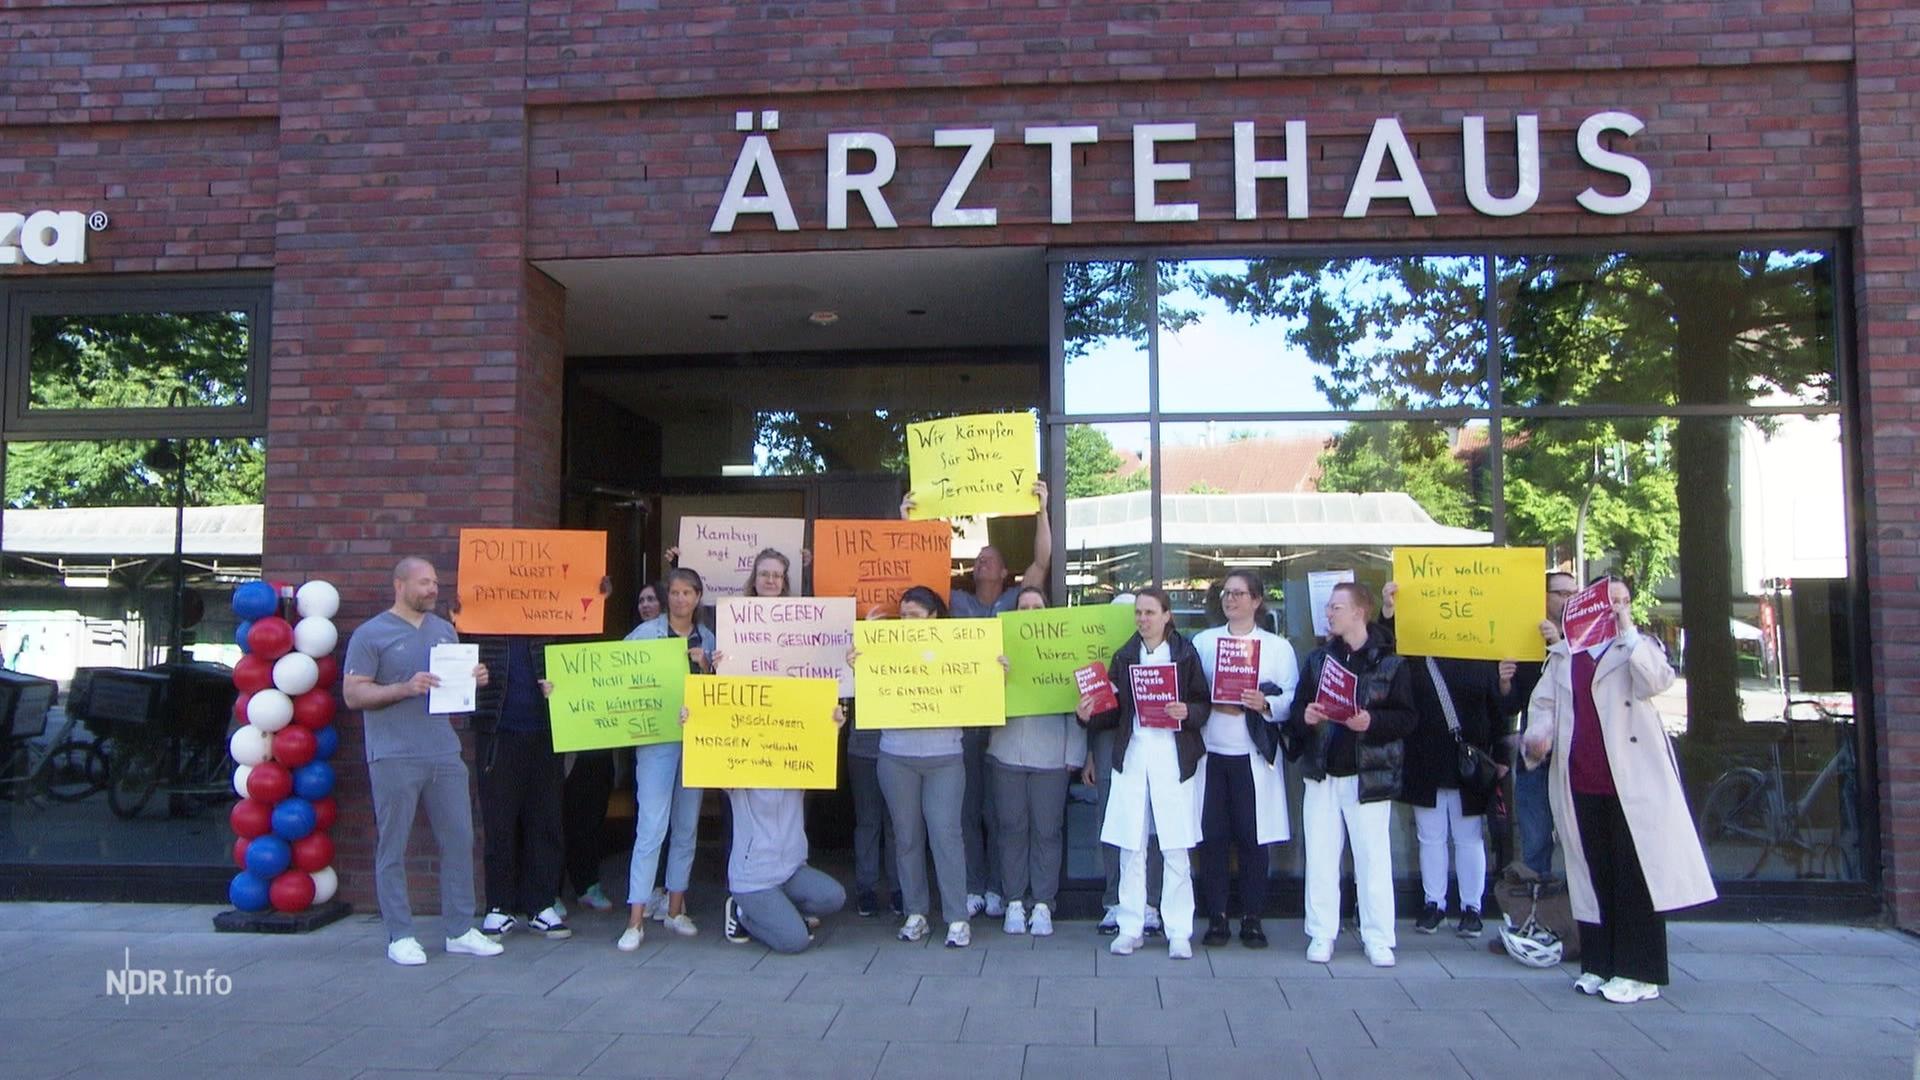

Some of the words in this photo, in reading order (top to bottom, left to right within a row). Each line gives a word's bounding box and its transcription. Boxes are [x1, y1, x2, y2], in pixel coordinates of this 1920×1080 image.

[711, 111, 1651, 232] ÄRZTEHAUS
[914, 424, 945, 448] Wir
[956, 420, 1014, 442] kämpfen
[940, 452, 961, 469] für
[932, 478, 1004, 500] Termine
[835, 525, 877, 556] IHR
[882, 530, 950, 552] TERMIN
[469, 539, 552, 562] POLITIK
[509, 565, 555, 578] KÜRZT
[859, 558, 912, 577] STIRBT
[1408, 553, 1443, 579] Wir
[1455, 560, 1501, 575] wollen
[473, 585, 561, 601] PATIENTEN
[1421, 586, 1457, 597] weiter
[521, 606, 574, 621] WARTEN
[730, 602, 766, 623] WIR
[770, 603, 826, 623] GEBEN
[733, 629, 772, 644] IHRER
[777, 629, 854, 647] GESUNDHEIT
[864, 625, 943, 643] WENIGER
[953, 627, 986, 640] GELD
[1020, 621, 1070, 640] OHNE
[1036, 644, 1079, 660] hören
[1087, 645, 1112, 660] SIE
[1219, 640, 1247, 649] Diese
[560, 648, 602, 674] WIR
[610, 650, 651, 668] SIND
[1219, 649, 1249, 658] Praxis
[751, 656, 780, 672] EINE
[869, 664, 930, 676] WENIGER
[941, 661, 980, 675] ARZT
[1218, 664, 1256, 674] bedroht.
[1032, 672, 1070, 686] nichts
[1132, 668, 1160, 677] Diese
[1134, 675, 1164, 686] Praxis
[702, 682, 773, 707] HEUTE
[1135, 684, 1147, 693] ist
[568, 699, 595, 712] WIR
[606, 697, 663, 711] KÄMPFEN
[1136, 693, 1175, 701] bedroht.
[628, 713, 660, 734] SIE
[731, 714, 805, 729] geschlossen
[695, 736, 750, 748] MORGEN
[728, 757, 748, 770] gar
[784, 760, 815, 773] MEHR
